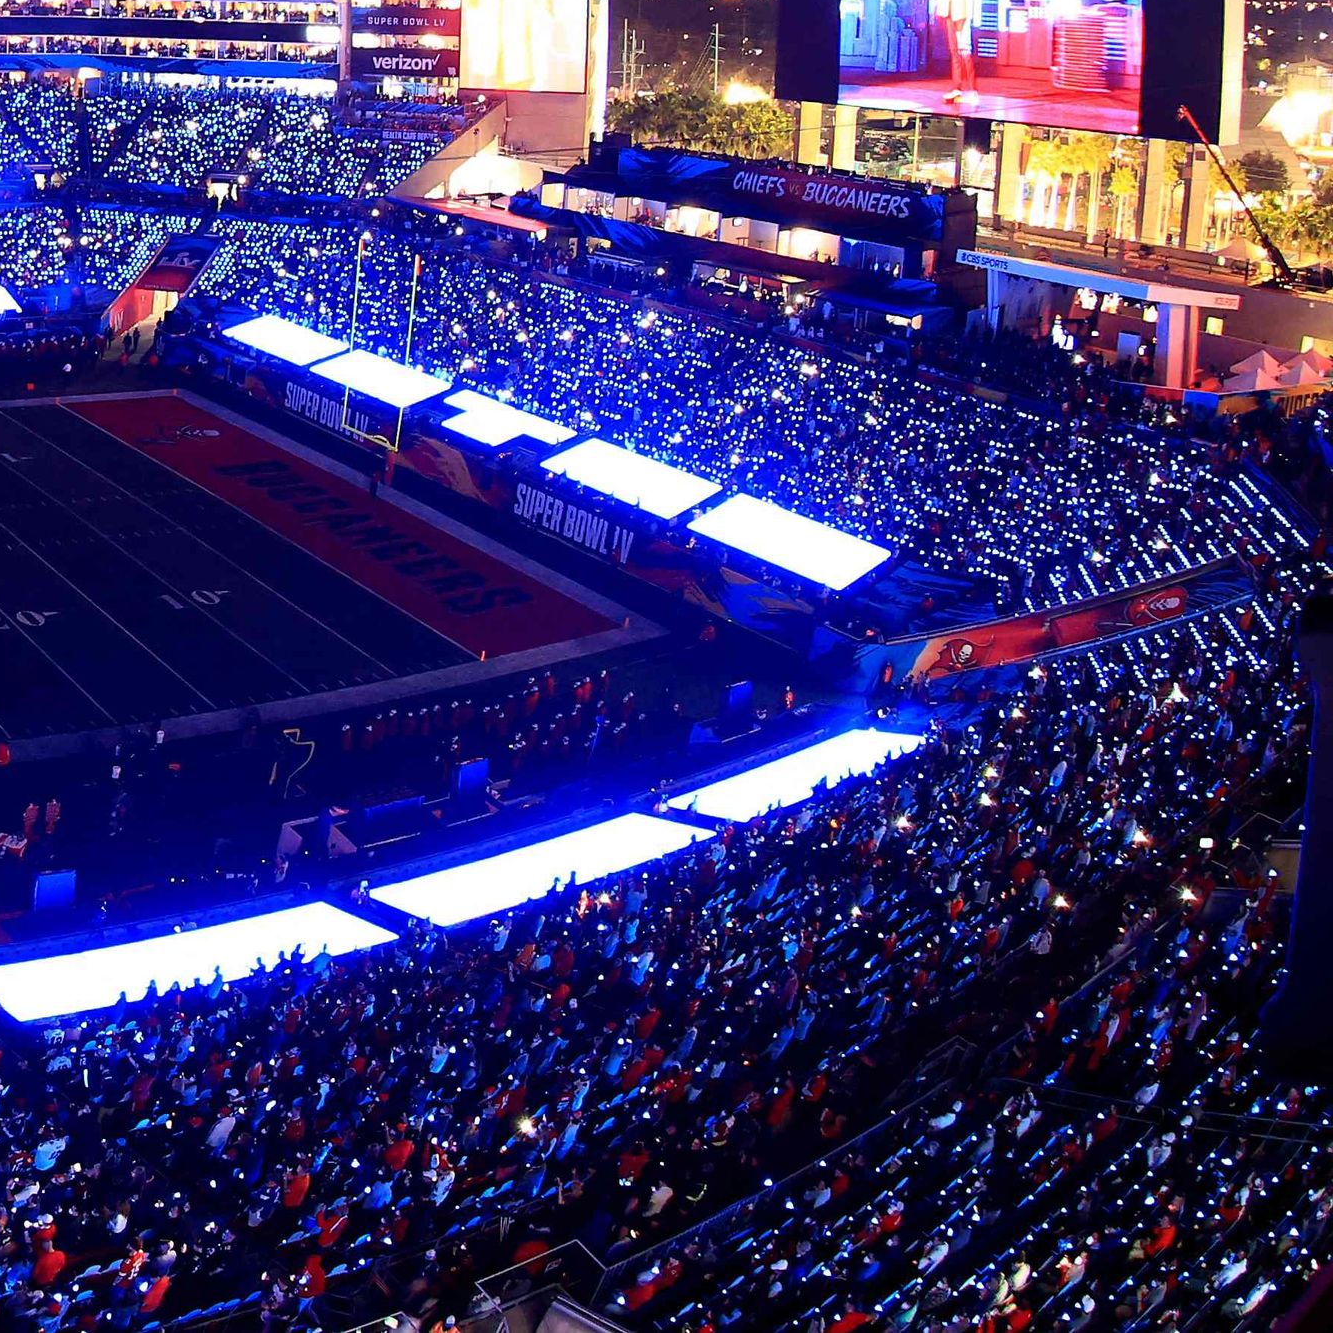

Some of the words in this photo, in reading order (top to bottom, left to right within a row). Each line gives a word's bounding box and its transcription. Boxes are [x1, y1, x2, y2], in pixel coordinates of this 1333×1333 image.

[367, 17, 399, 25] SUPER
[403, 17, 430, 26] BOWL
[434, 18, 445, 27] LV
[372, 54, 432, 71] verizon
[733, 171, 786, 197] CHIEFS
[802, 182, 910, 218] BUCCANEERS
[967, 253, 980, 265] CBS
[981, 256, 1009, 270] SPORTS
[285, 381, 319, 422] SUPER
[319, 397, 351, 437] BOWL
[514, 483, 565, 534] SUPER
[563, 504, 609, 556] BOWL
[214, 460, 533, 614] BUCCANEERS
[157, 589, 220, 610] 10
